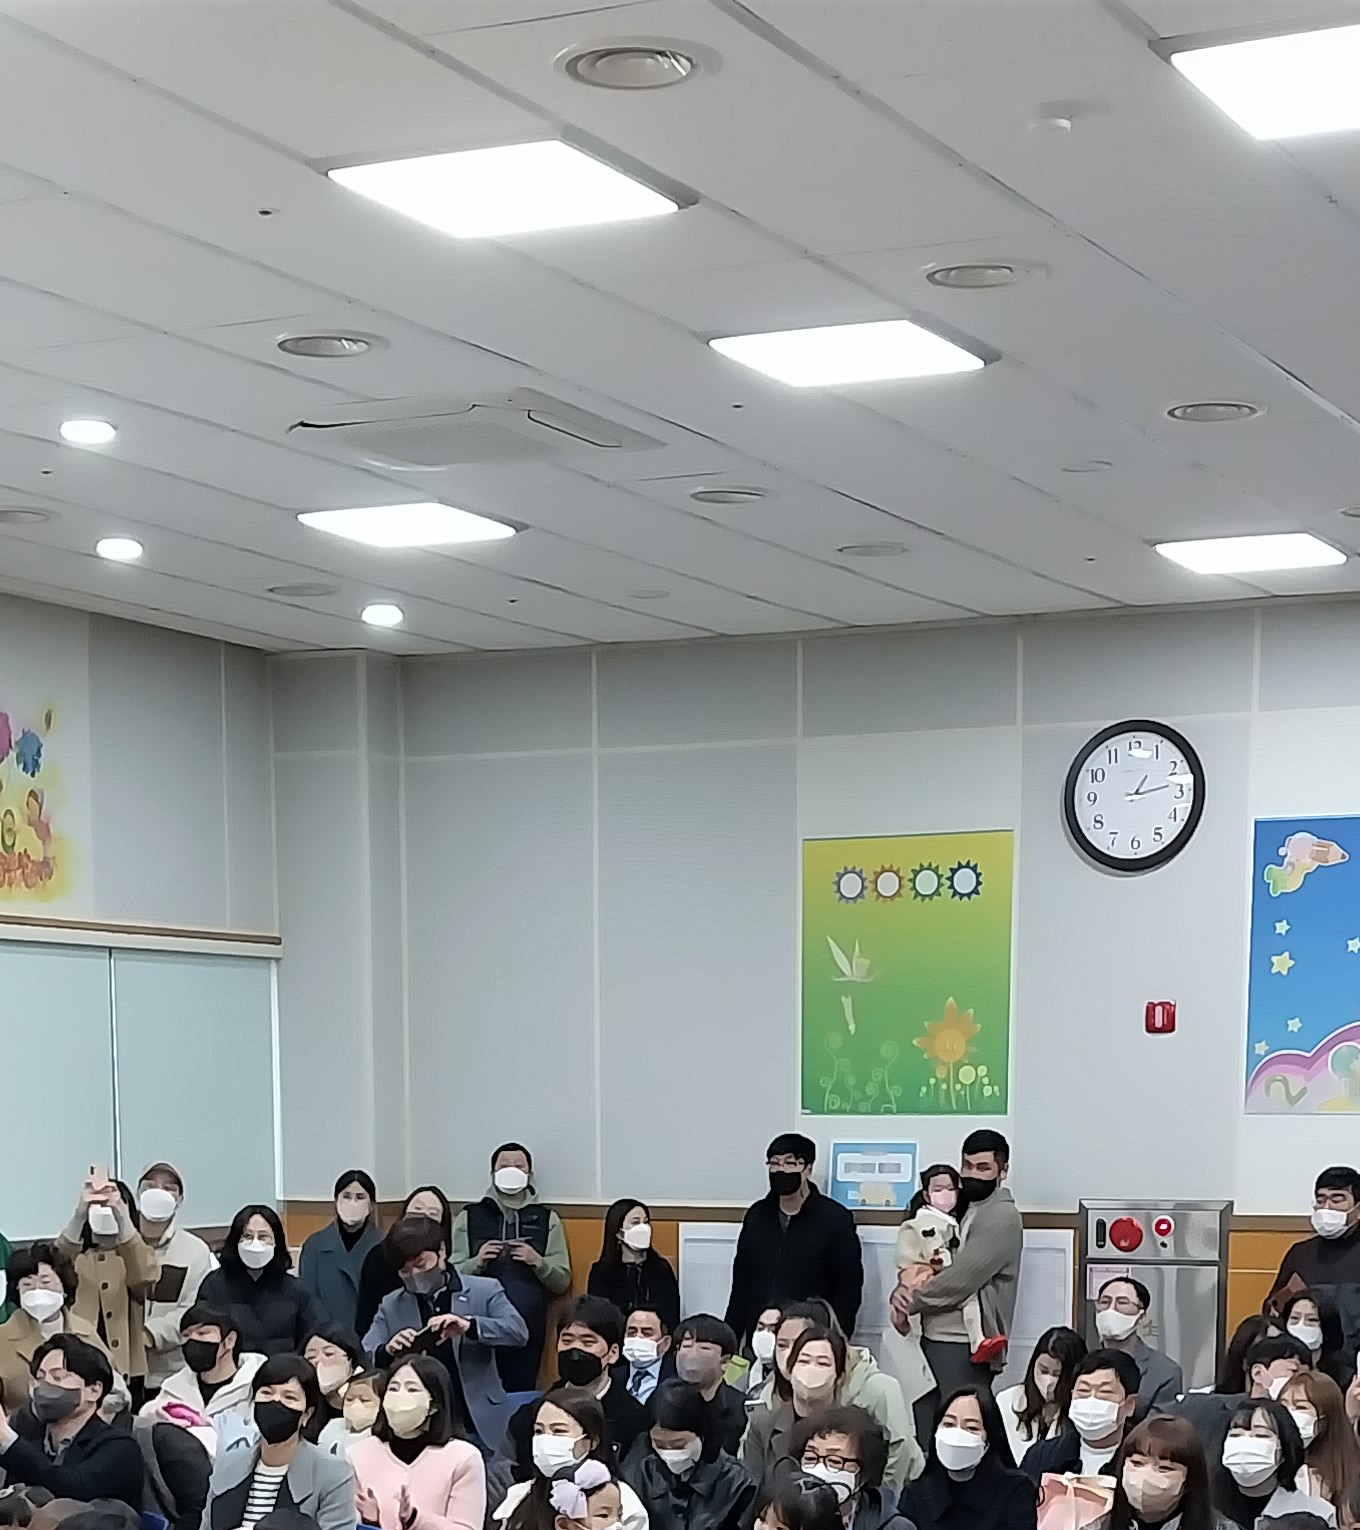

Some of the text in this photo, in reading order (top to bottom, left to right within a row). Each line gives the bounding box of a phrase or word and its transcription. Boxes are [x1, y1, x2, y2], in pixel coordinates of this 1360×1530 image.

[1107, 747, 1119, 765] 11
[1154, 743, 1160, 760] 1
[1090, 767, 1106, 784] 10
[1168, 760, 1178, 777] 2
[1087, 791, 1098, 807] 9
[1174, 783, 1185, 800] 3
[1092, 813, 1105, 830] 8
[1167, 806, 1177, 823] 4
[1108, 831, 1119, 847] 7
[1130, 835, 1141, 850] 6
[1152, 826, 1163, 843] 5
